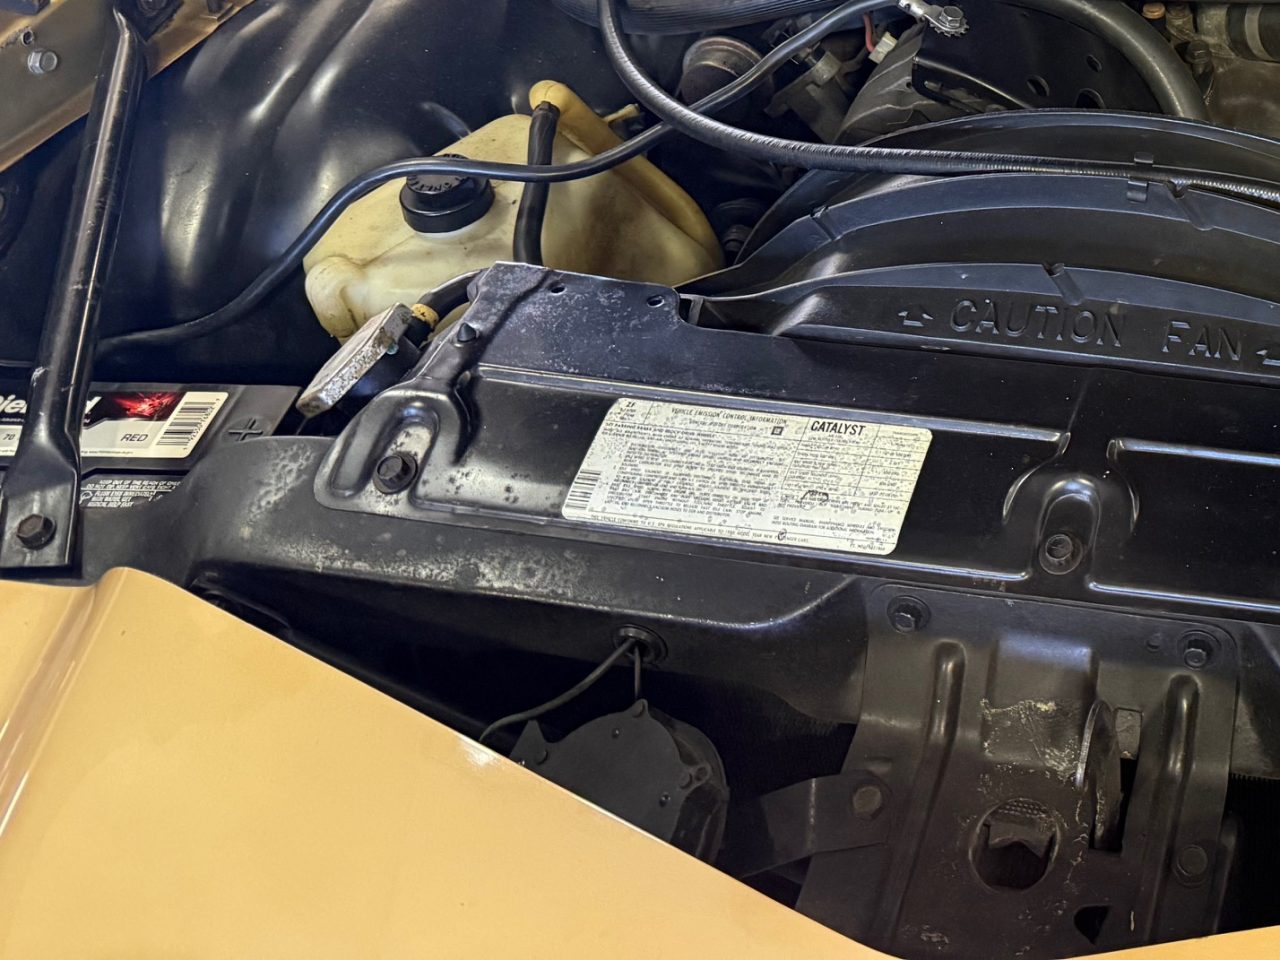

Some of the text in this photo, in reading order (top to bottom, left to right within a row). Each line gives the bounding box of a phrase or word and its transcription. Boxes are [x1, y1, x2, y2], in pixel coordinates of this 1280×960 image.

[949, 298, 1242, 362] CAUTION FAN
[694, 410, 720, 418] EMISSION
[723, 413, 746, 421] CONTROL
[748, 415, 787, 424] INFORMATION
[811, 421, 866, 436] CATALYST
[120, 433, 149, 442] RED
